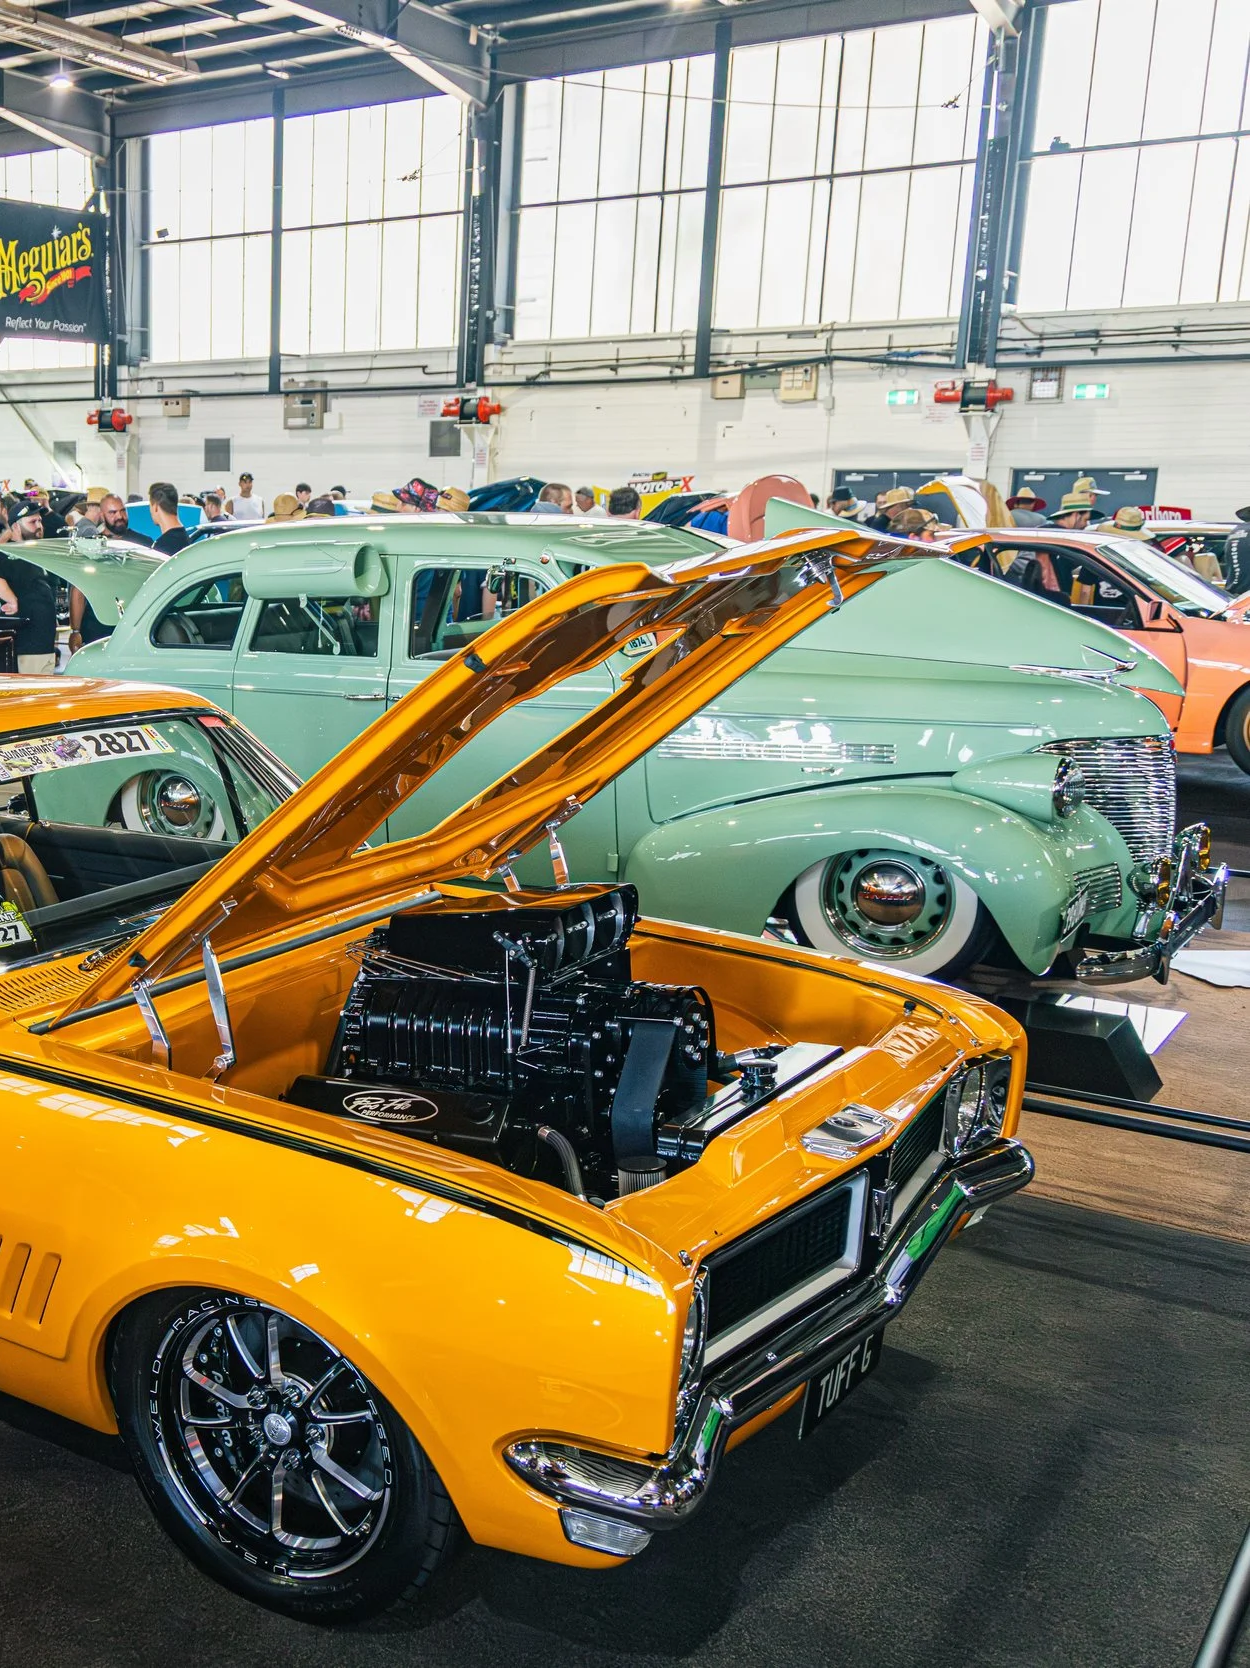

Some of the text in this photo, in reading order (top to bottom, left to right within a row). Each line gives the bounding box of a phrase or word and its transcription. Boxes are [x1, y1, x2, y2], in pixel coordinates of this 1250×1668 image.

[5, 317, 32, 330] Reflect
[34, 318, 52, 330] Your
[82, 730, 151, 757] 2827
[28, 756, 42, 766] 38
[361, 1109, 417, 1121] PERFORMANCE
[172, 1297, 258, 1331] RACING
[817, 1334, 874, 1418] TUFF G
[150, 1359, 162, 1440] WELD
